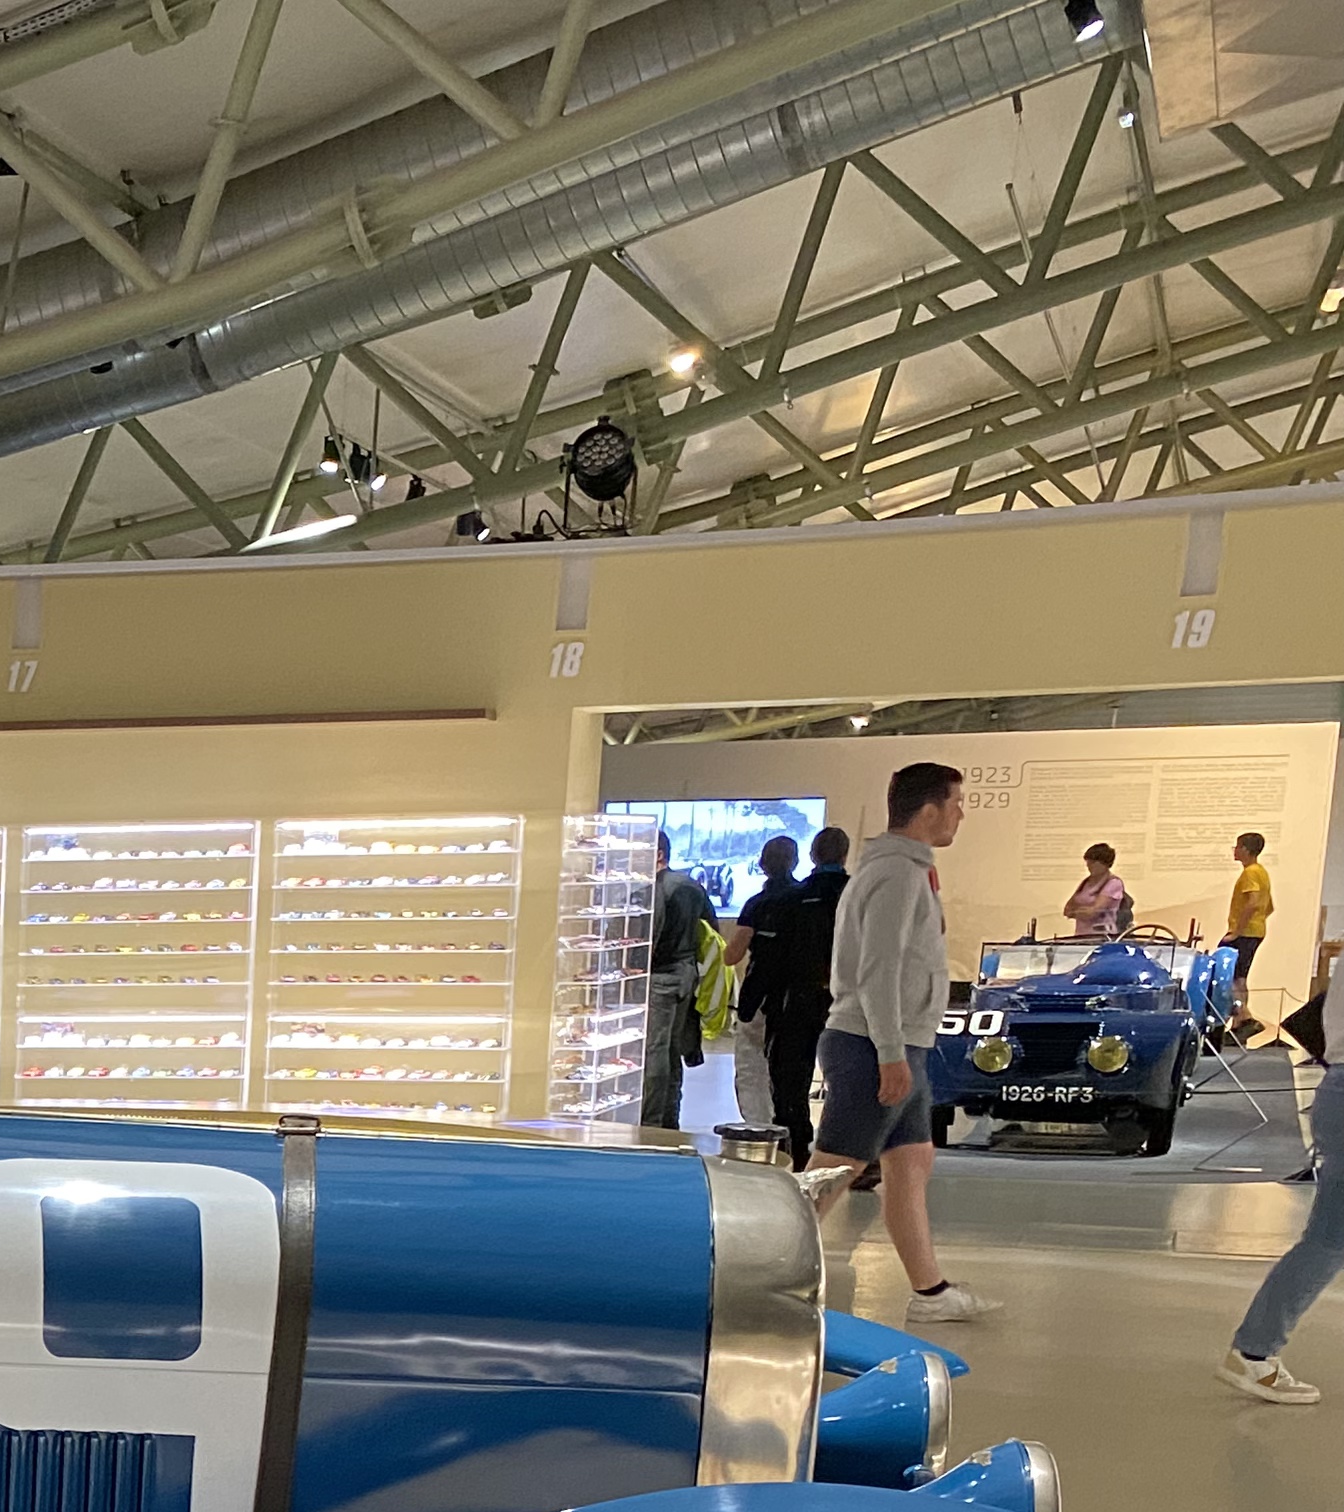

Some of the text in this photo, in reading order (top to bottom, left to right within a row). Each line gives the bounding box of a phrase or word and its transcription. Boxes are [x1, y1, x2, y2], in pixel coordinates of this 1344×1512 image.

[1171, 608, 1216, 649] 19
[549, 641, 585, 678] 18
[7, 660, 39, 693] 17
[961, 765, 1012, 784] 1923
[1001, 1084, 1095, 1104] 1926-RF3
